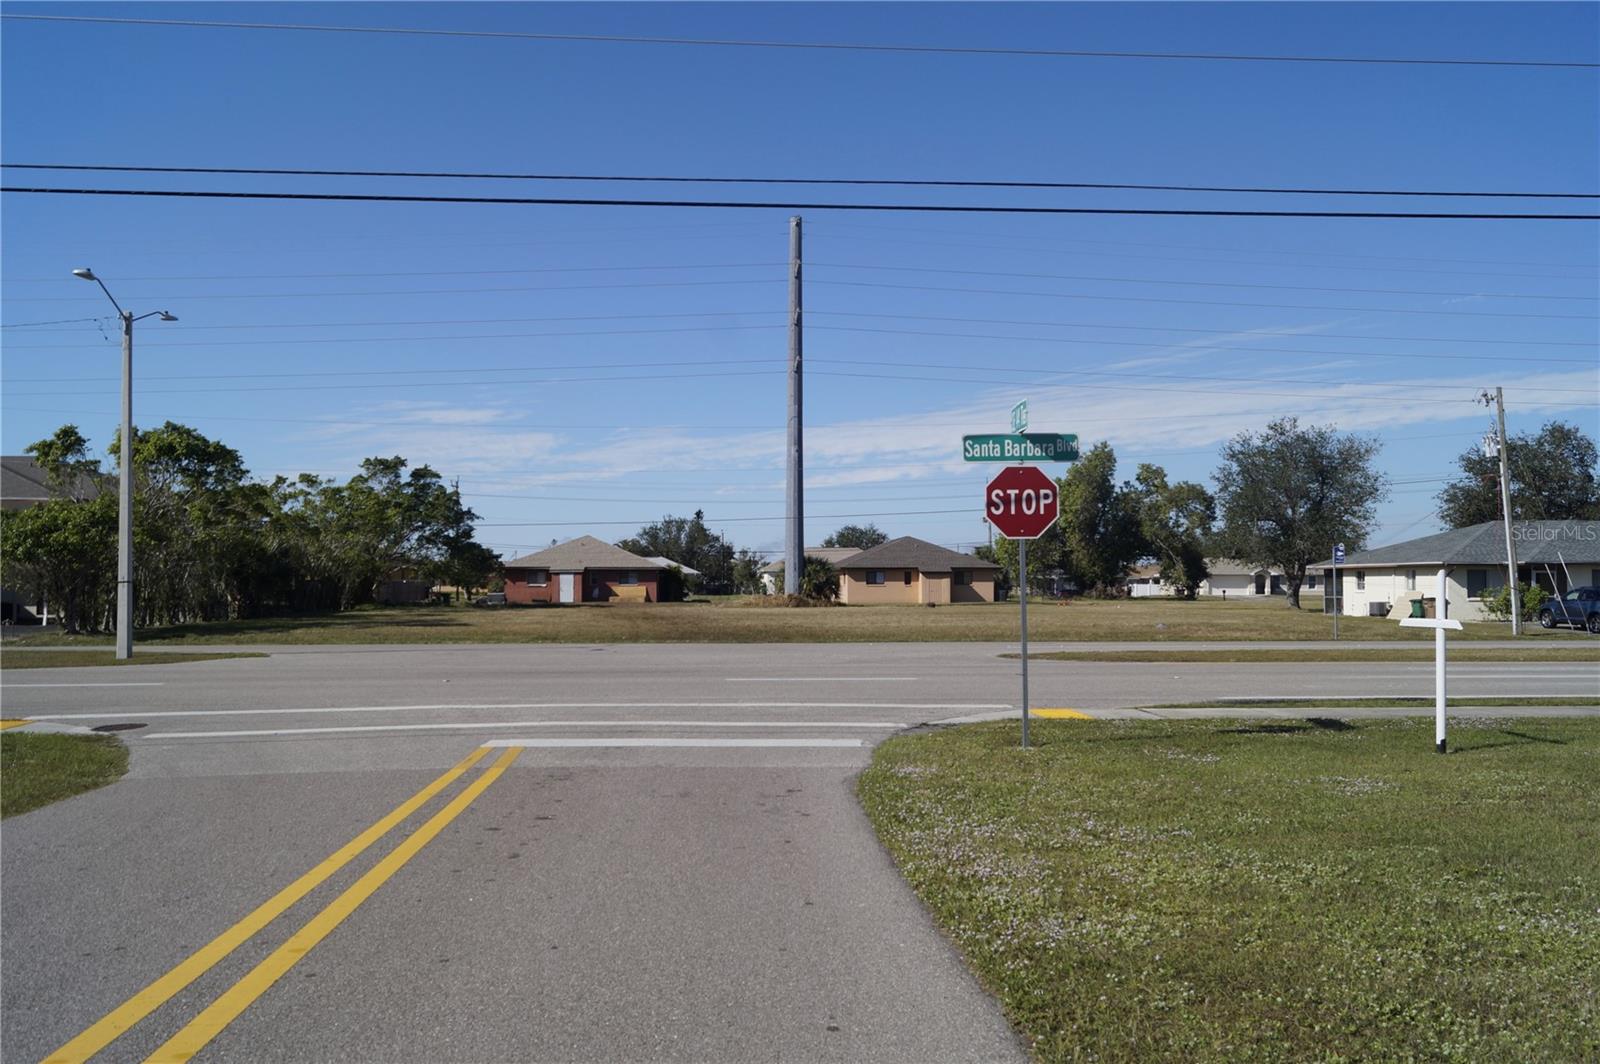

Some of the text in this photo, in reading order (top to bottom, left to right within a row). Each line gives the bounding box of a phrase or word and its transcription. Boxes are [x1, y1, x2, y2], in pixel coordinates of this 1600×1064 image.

[965, 439, 1078, 457] Santa Barbara Blvd
[990, 489, 1053, 515] STOP
